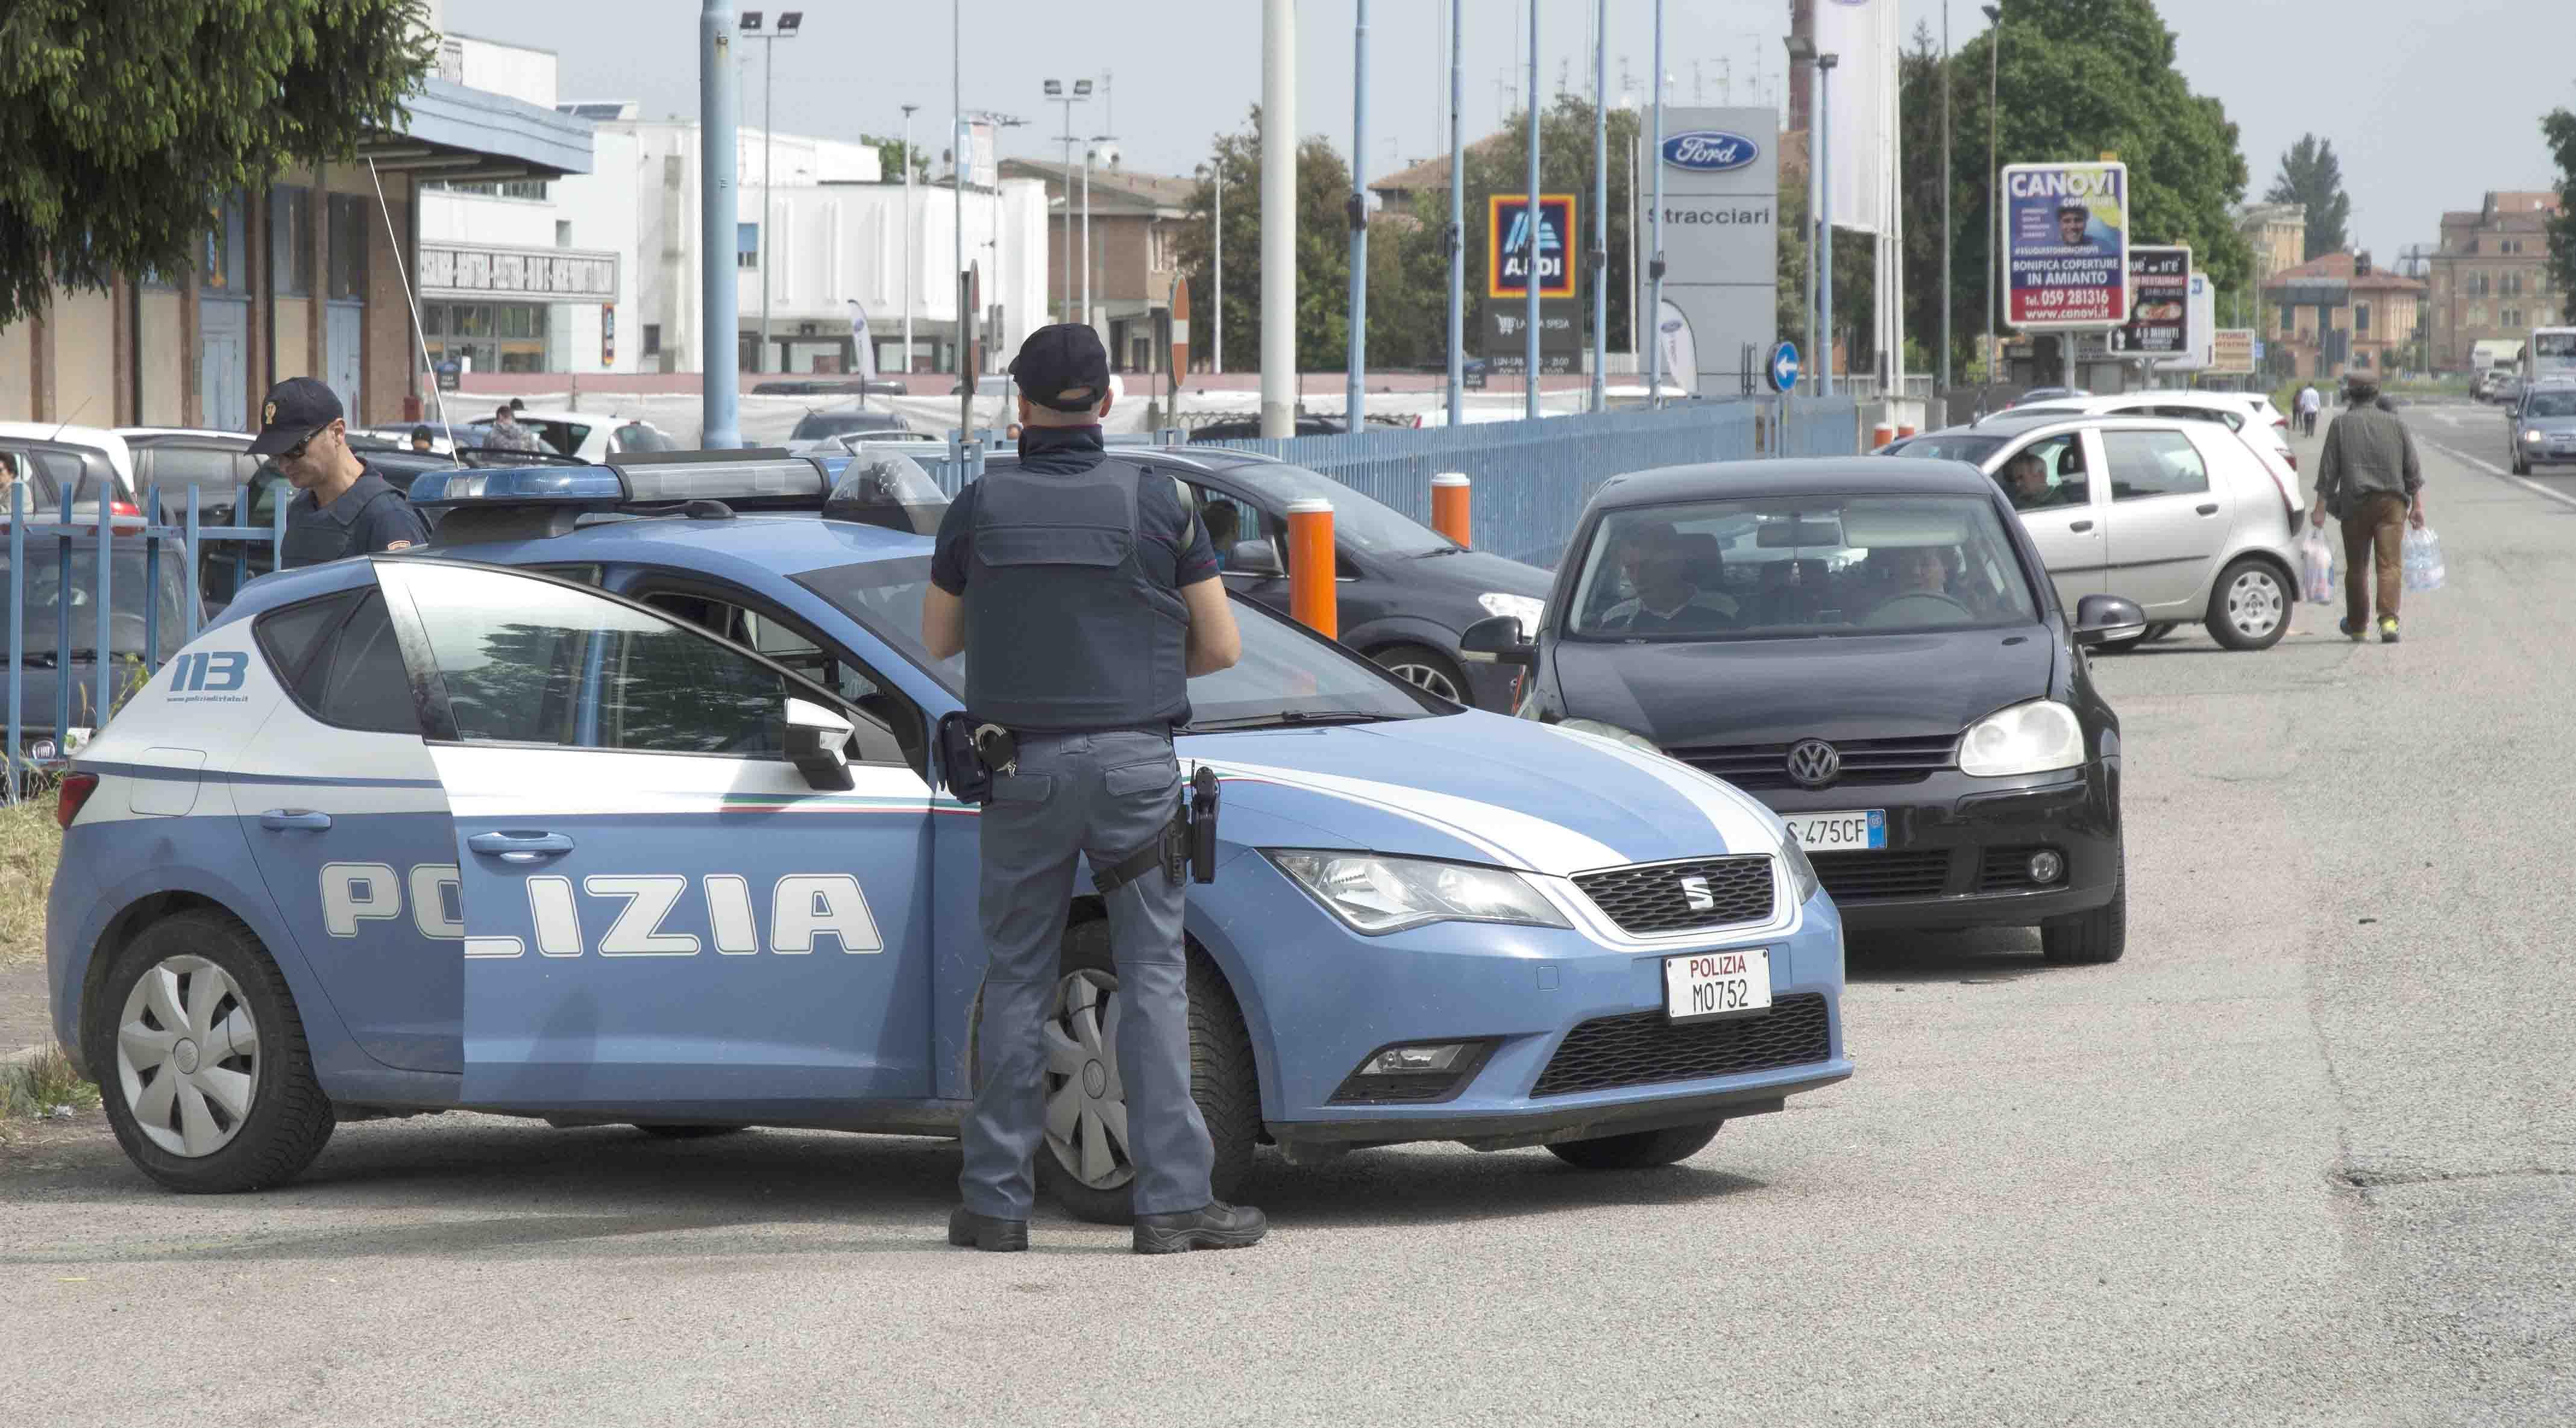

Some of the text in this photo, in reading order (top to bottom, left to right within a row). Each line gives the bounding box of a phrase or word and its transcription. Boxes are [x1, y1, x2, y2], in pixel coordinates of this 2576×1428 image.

[1676, 136, 1738, 163] Ford
[2011, 172, 2114, 197] CANOVI
[2013, 258, 2119, 271] BONIFICA COPERTURE
[2027, 272, 2108, 286] IN AMIANTO
[2041, 290, 2064, 305] 059
[2067, 289, 2109, 305] 281316
[2025, 305, 2109, 319] www.canovi.it
[169, 651, 250, 692] 113
[1805, 819, 1866, 844] 475CF
[319, 861, 884, 959] POIZIA
[1689, 954, 1747, 979] POLIZIA
[1692, 979, 1749, 1013] M0752
